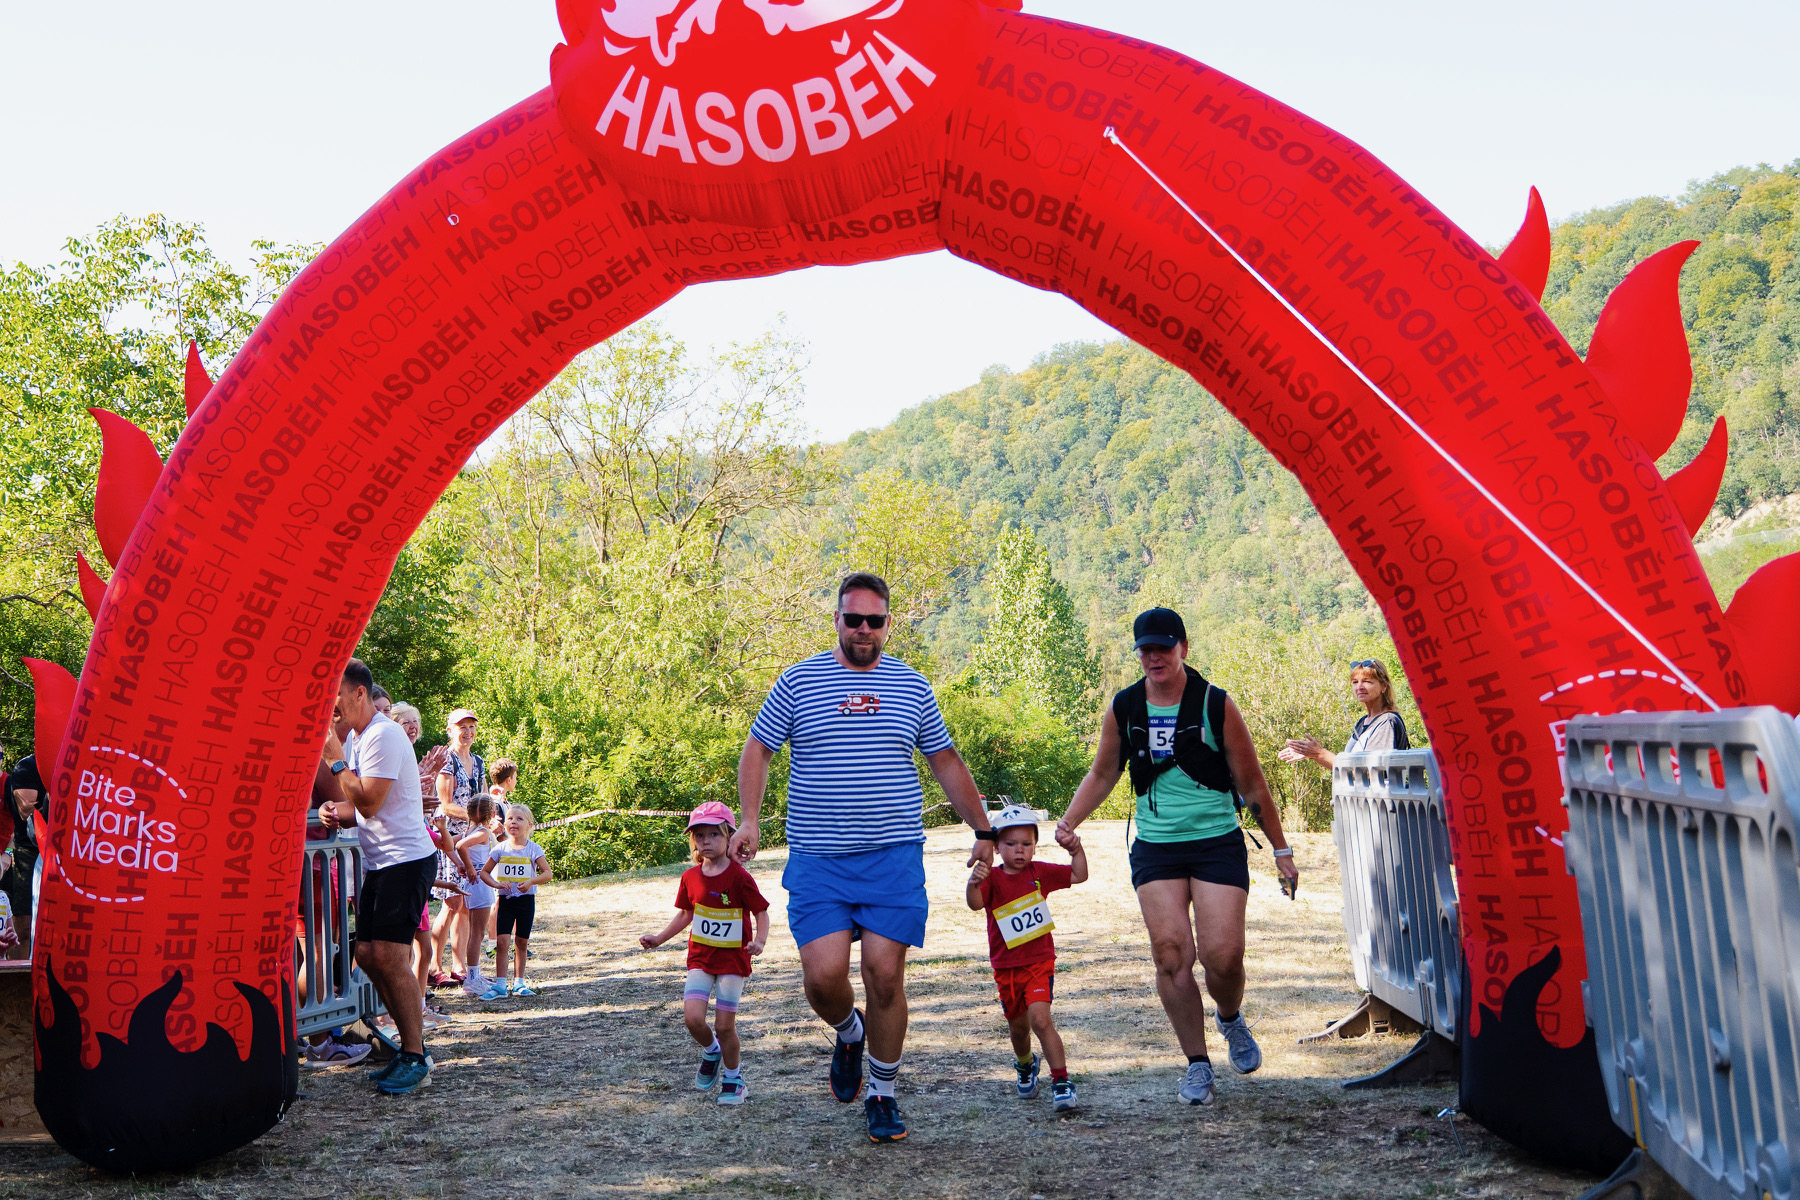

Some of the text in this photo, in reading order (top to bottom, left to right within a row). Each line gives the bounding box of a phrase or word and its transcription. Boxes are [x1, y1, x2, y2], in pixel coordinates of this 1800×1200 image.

[594, 30, 937, 166] HASOBĚH
[995, 20, 1190, 103] HASOBĚH
[1192, 93, 1393, 230] HASOBĚH
[1380, 220, 1547, 391] HASOBĚH
[1535, 392, 1676, 617] HASOBĚH
[110, 521, 197, 707] HASOBĚH
[182, 361, 293, 521] HASOBĚH
[279, 224, 422, 374] HASOBĚH
[154, 542, 240, 705] HASOBĚH
[219, 383, 338, 544] HASOBĚH
[319, 261, 452, 396] HASOBĚH
[444, 159, 608, 276] HASOBĚH
[168, 738, 229, 899] HASOBĚH
[201, 567, 289, 733] HASOBĚH
[268, 426, 374, 567] HASOBĚH
[352, 304, 488, 439] HASOBĚH
[479, 211, 621, 317] HASOBĚH
[220, 738, 277, 899] HASOBĚH
[254, 585, 331, 729] HASOBĚH
[312, 445, 417, 584] HASOBĚH
[399, 339, 518, 452] HASOBĚH
[510, 246, 653, 347] HASOBĚH
[264, 755, 308, 898] HASOBĚH
[293, 600, 362, 745] HASOBĚH
[352, 474, 442, 593] HASOBĚH
[427, 365, 541, 477] HASOBĚH
[539, 282, 662, 366] HASOBĚH
[942, 159, 1106, 250] HASOBĚH
[1109, 232, 1262, 349] HASOBĚH
[1246, 331, 1392, 490] HASOBĚH
[1378, 486, 1490, 664] HASOBĚH
[1466, 669, 1551, 879] HASOBĚH
[951, 209, 1092, 289] HASOBĚH
[1098, 275, 1243, 391] HASOBĚH
[1236, 374, 1355, 514] HASOBĚH
[1347, 514, 1450, 692] HASOBĚH
[1436, 700, 1500, 880] HASOBĚH
[1131, 176, 1312, 316] HASOBĚH
[1426, 451, 1559, 660] HASOBĚH
[1159, 130, 1342, 259] HASOBĚH
[1325, 241, 1500, 423] HASOBĚH
[1480, 419, 1612, 621] HASOBĚH
[70, 829, 179, 873] Media
[74, 798, 177, 844] Marks
[77, 769, 136, 807] Bite
[504, 864, 525, 876] 018
[1693, 600, 1748, 709] HAS
[701, 919, 732, 938] 027
[1010, 906, 1044, 933] 026
